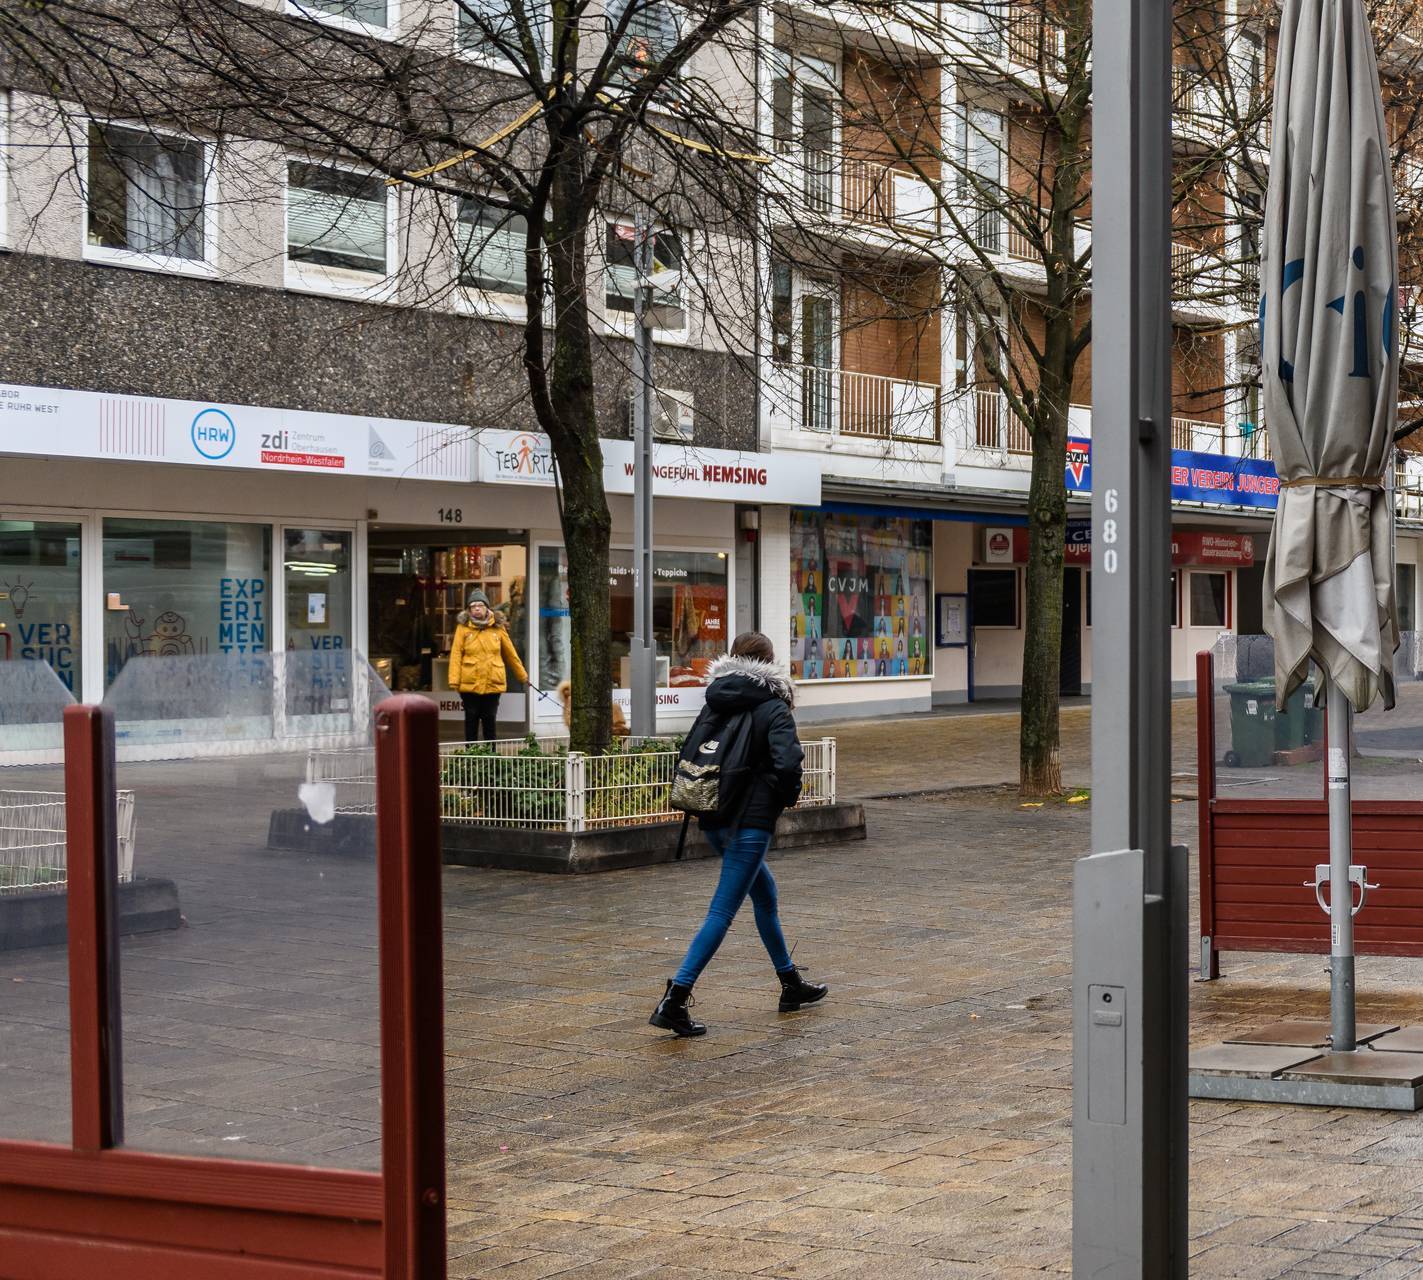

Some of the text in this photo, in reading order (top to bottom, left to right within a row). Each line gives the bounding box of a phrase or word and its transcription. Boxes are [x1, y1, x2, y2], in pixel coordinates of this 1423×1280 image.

[0, 390, 20, 399] BOR
[8, 402, 32, 411] RUHR
[34, 404, 60, 413] WEST
[197, 427, 230, 442] HRW
[261, 430, 289, 450] zdi
[262, 452, 344, 467] Nordrhein-Westfalen
[1066, 452, 1089, 463] CVJM
[624, 463, 768, 486] WNGEFÜHL HEMSING
[1190, 467, 1235, 491] VEREIN
[437, 508, 463, 523] 148
[657, 567, 688, 578] Teppiche
[220, 578, 265, 599] EXP
[829, 576, 869, 593] CVJM
[220, 601, 262, 621] ERI
[18, 623, 71, 645] VER
[219, 623, 265, 643] MEN
[311, 635, 343, 650] VER
[440, 700, 465, 711] HEMS
